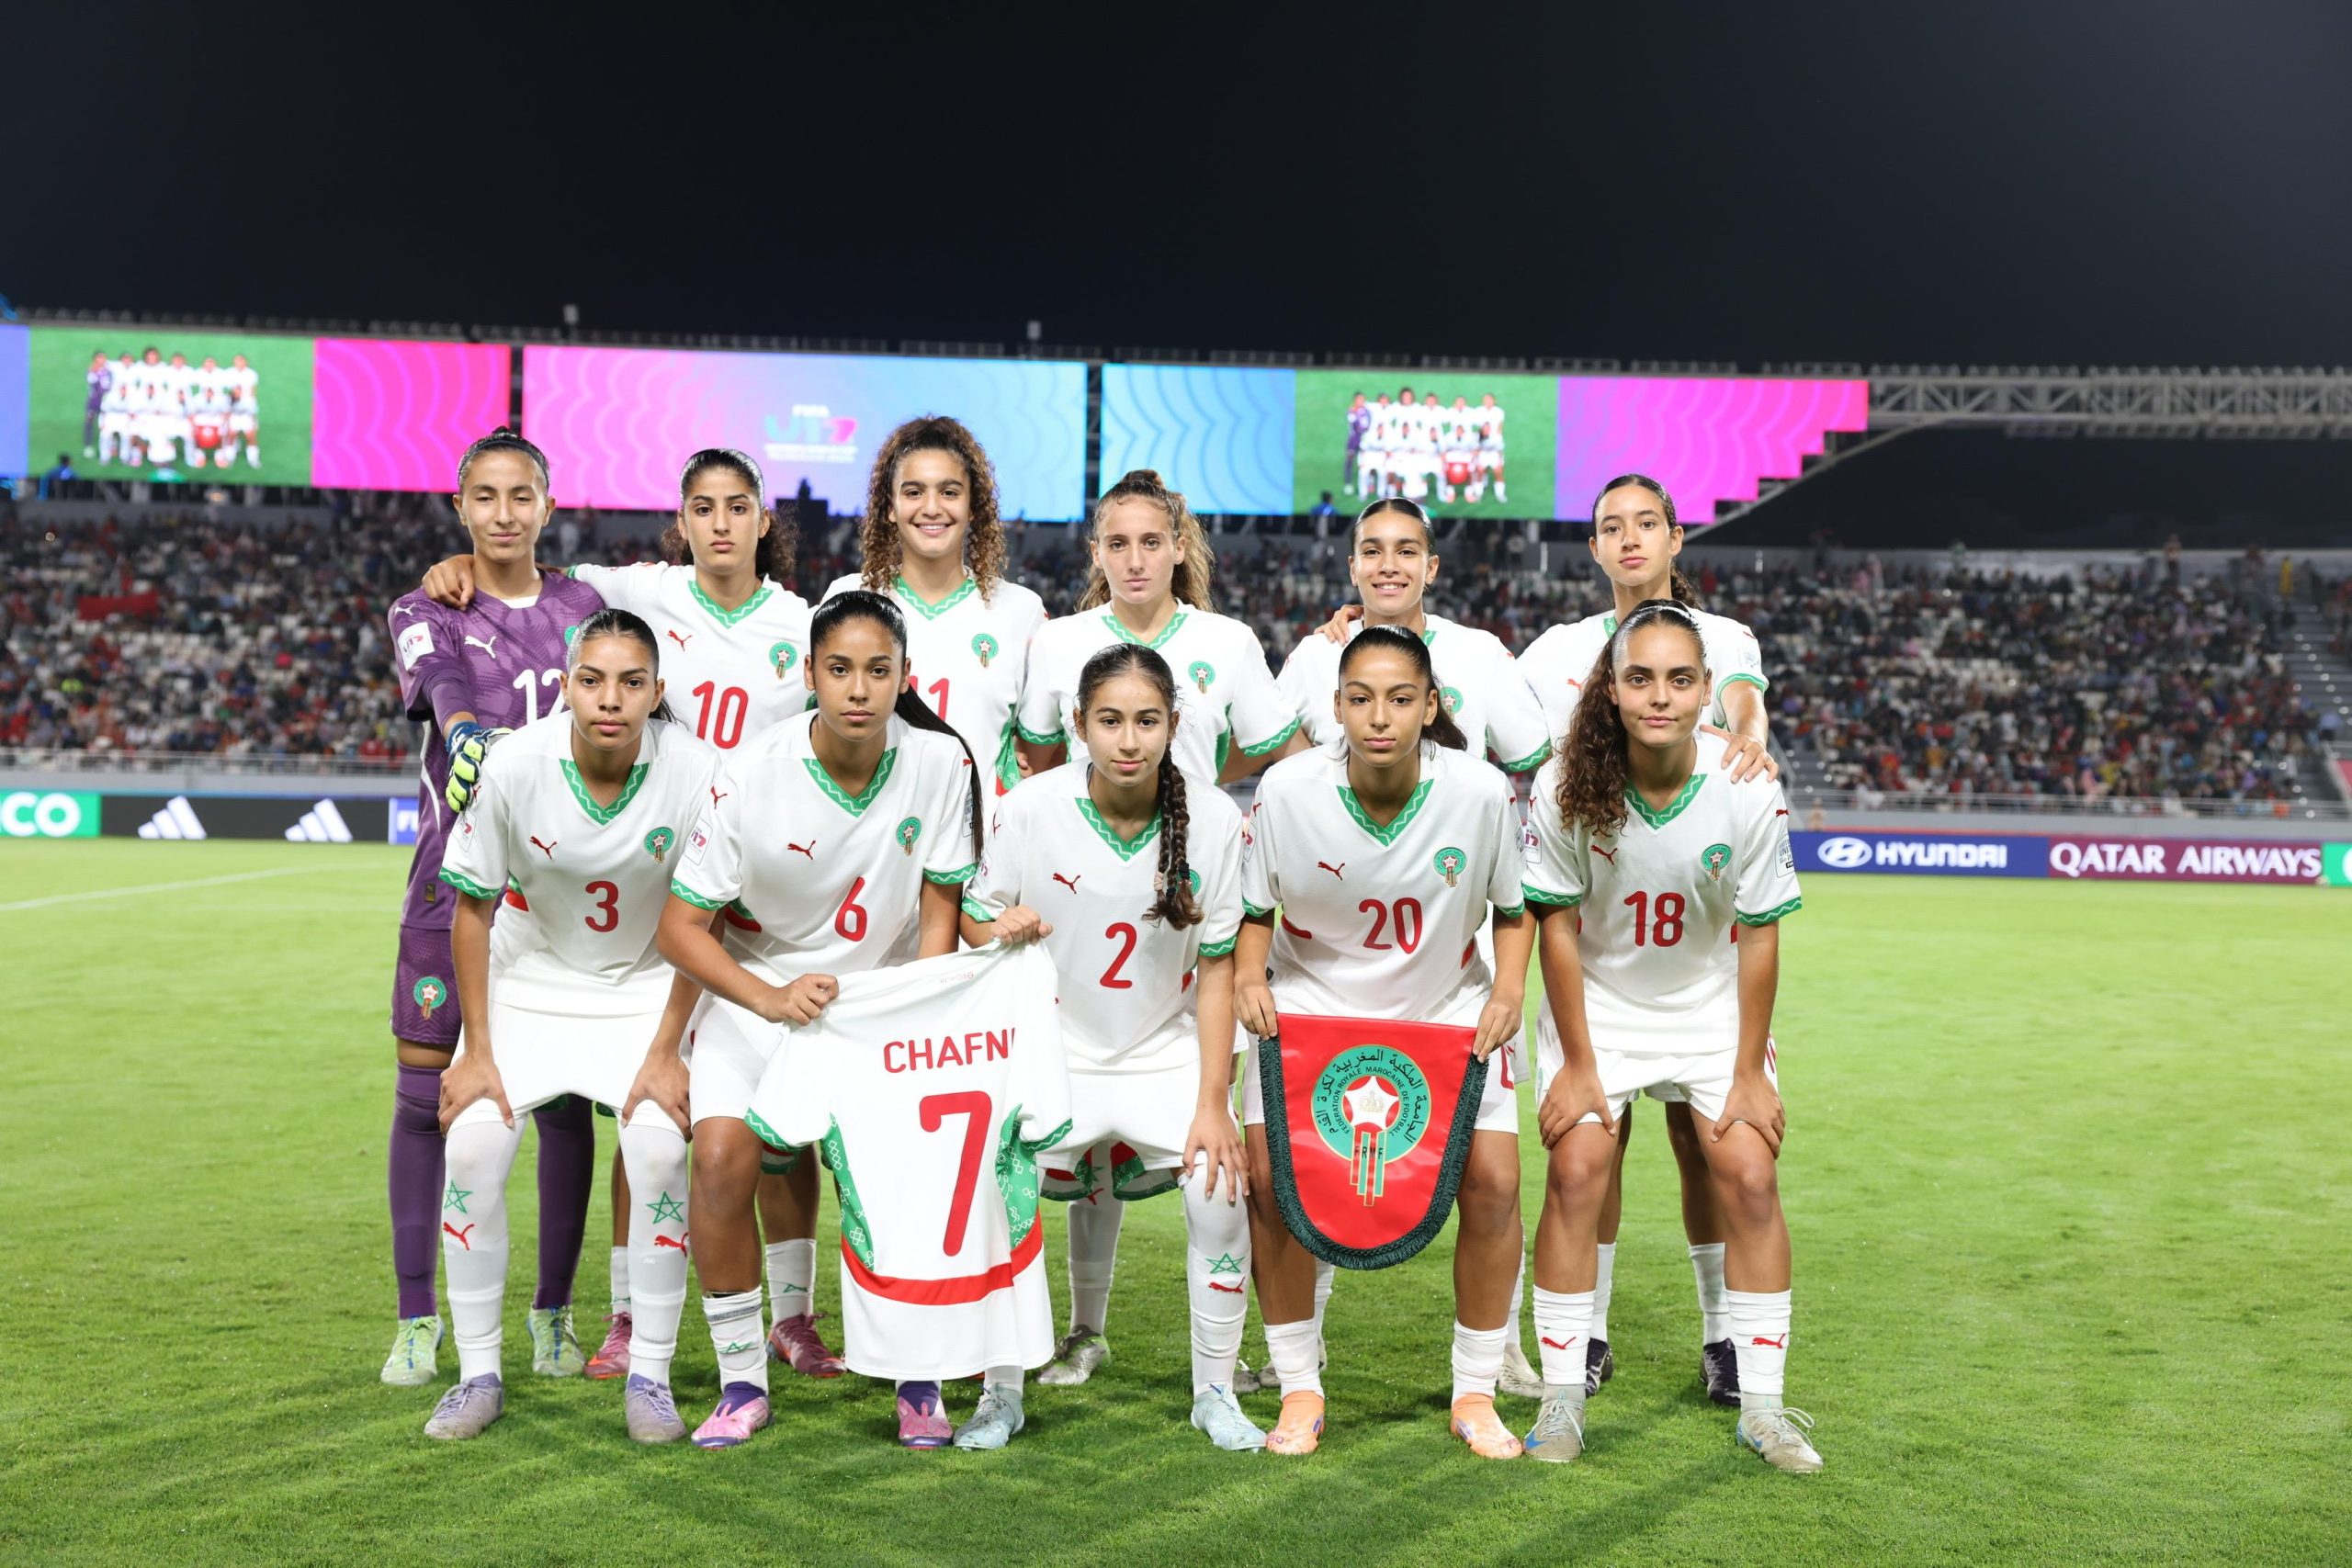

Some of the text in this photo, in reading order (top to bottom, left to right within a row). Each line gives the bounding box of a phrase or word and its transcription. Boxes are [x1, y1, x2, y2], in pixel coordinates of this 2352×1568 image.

[514, 669, 566, 725] 12
[692, 681, 749, 749] 10
[910, 675, 949, 722] 1
[1875, 840, 2007, 868] HYUNDAI
[2049, 842, 2166, 878] QATAR
[2176, 845, 2323, 877] AIRWAYS
[585, 880, 619, 932] 3
[834, 875, 868, 942] 6
[1358, 897, 1423, 954] 20
[1623, 890, 1686, 948] 18
[1100, 922, 1137, 989] 2
[1332, 1049, 1384, 1074] المغربية
[1338, 1068, 1363, 1089] ROYALE
[1365, 1066, 1406, 1089] MAROCAINE
[1401, 1090, 1410, 1101] DE
[1388, 1054, 1424, 1090] الملكية
[1317, 1074, 1335, 1102] لكرة
[1403, 1094, 1428, 1144] الجامعة
[919, 1090, 992, 1258] 7
